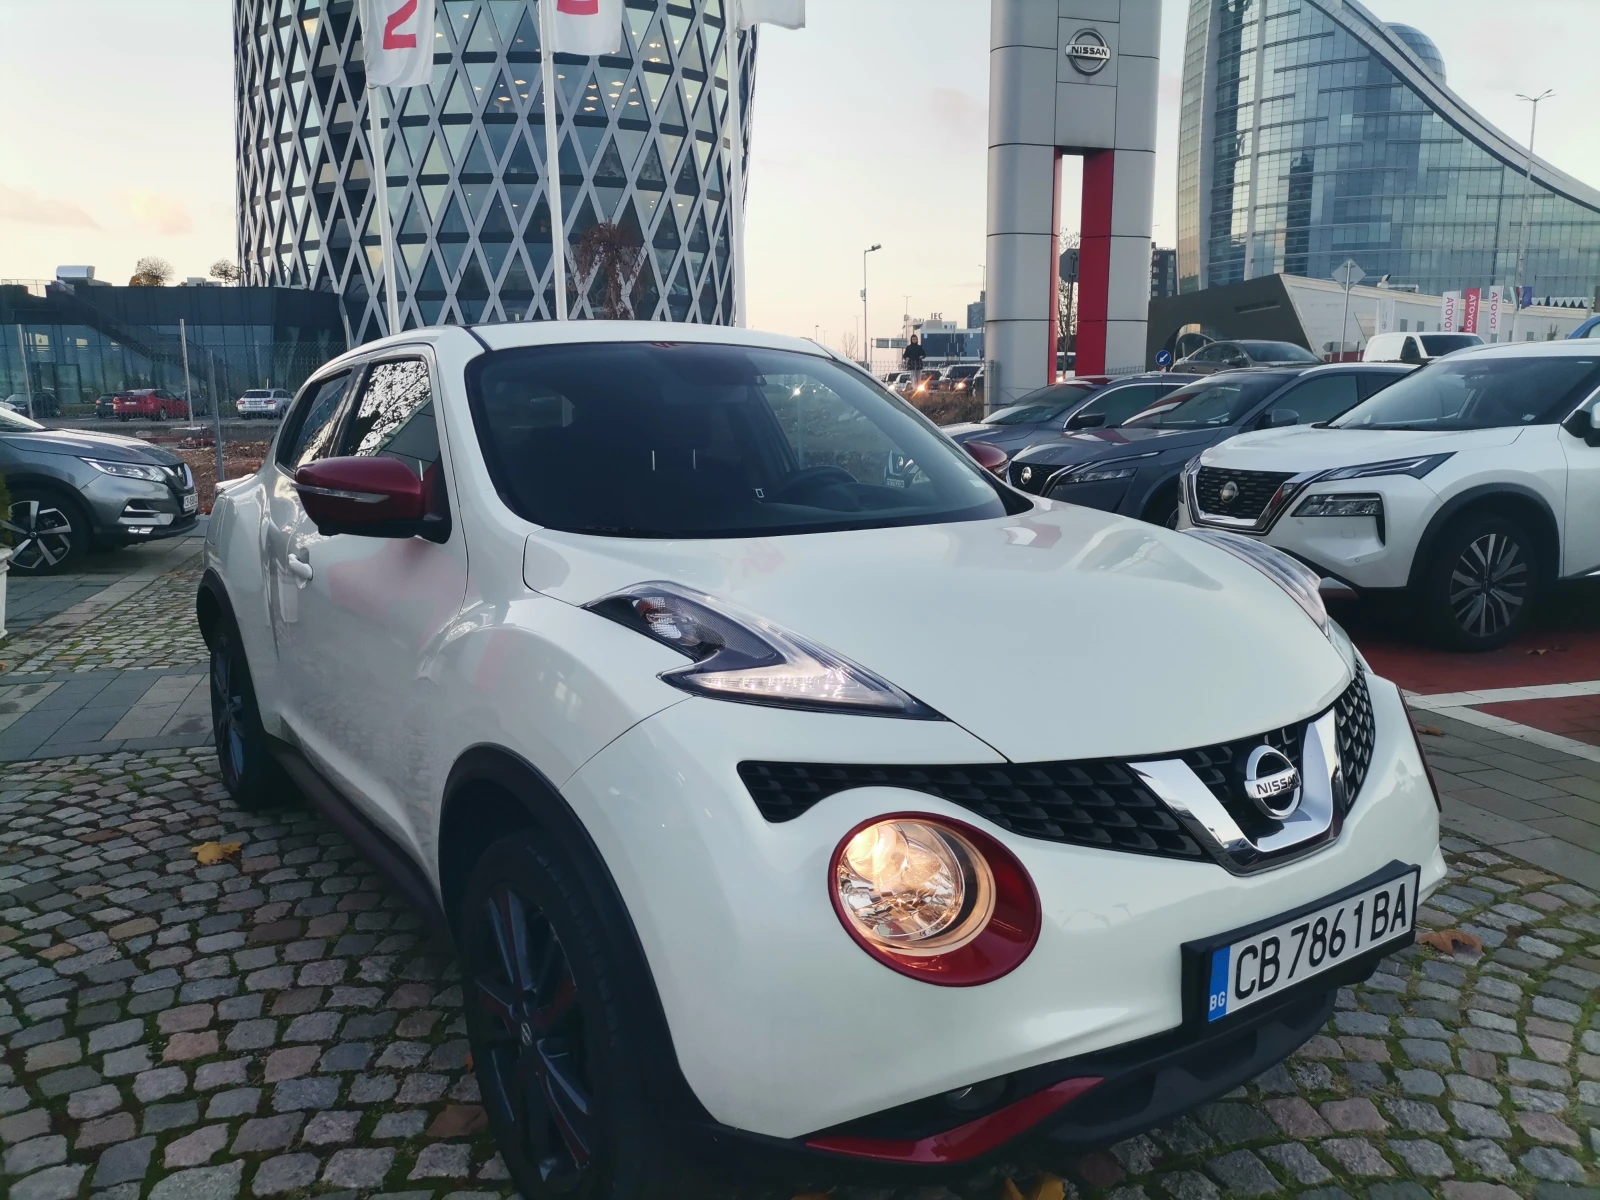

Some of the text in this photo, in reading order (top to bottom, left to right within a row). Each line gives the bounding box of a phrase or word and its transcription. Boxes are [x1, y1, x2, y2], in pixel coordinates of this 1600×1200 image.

[1071, 46, 1108, 57] NISSAN
[930, 312, 943, 320] IEC
[1256, 772, 1300, 795] NISSAN
[1209, 991, 1226, 1012] BG
